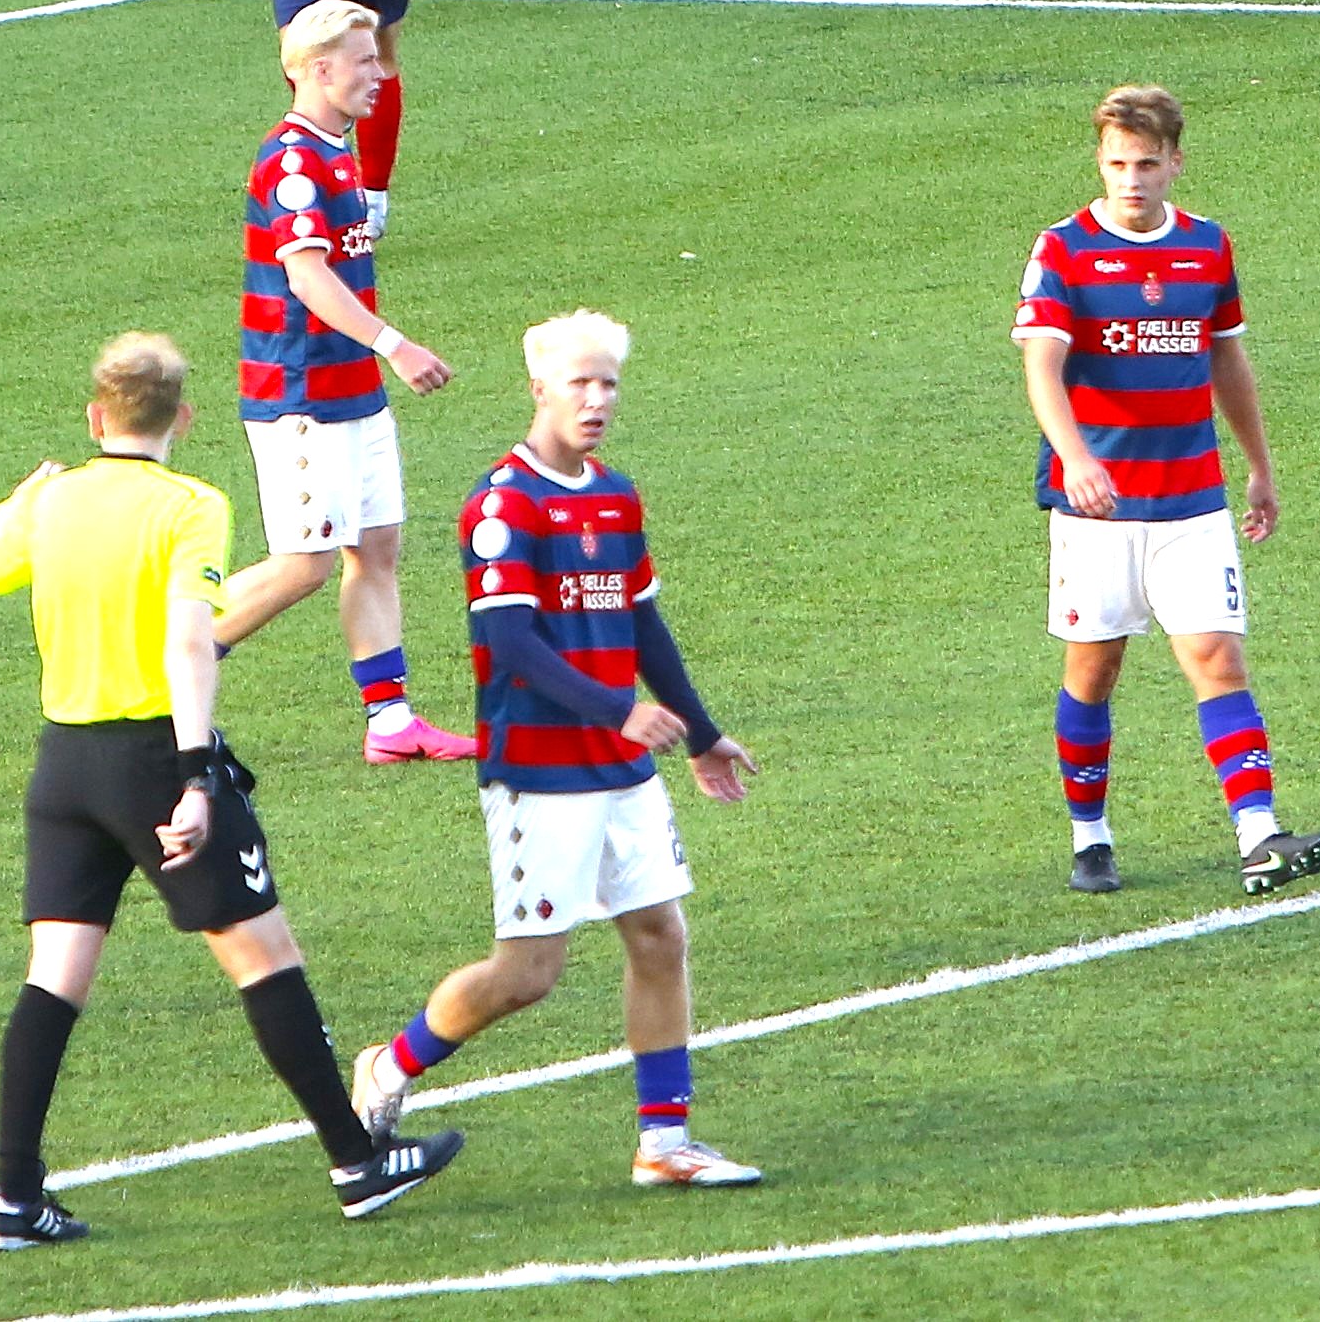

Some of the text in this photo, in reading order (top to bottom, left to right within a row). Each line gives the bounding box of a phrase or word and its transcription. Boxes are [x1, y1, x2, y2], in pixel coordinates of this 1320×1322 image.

[1137, 320, 1202, 337] FÆLLES
[1137, 337, 1200, 353] KASSEN
[1224, 567, 1239, 611] 5
